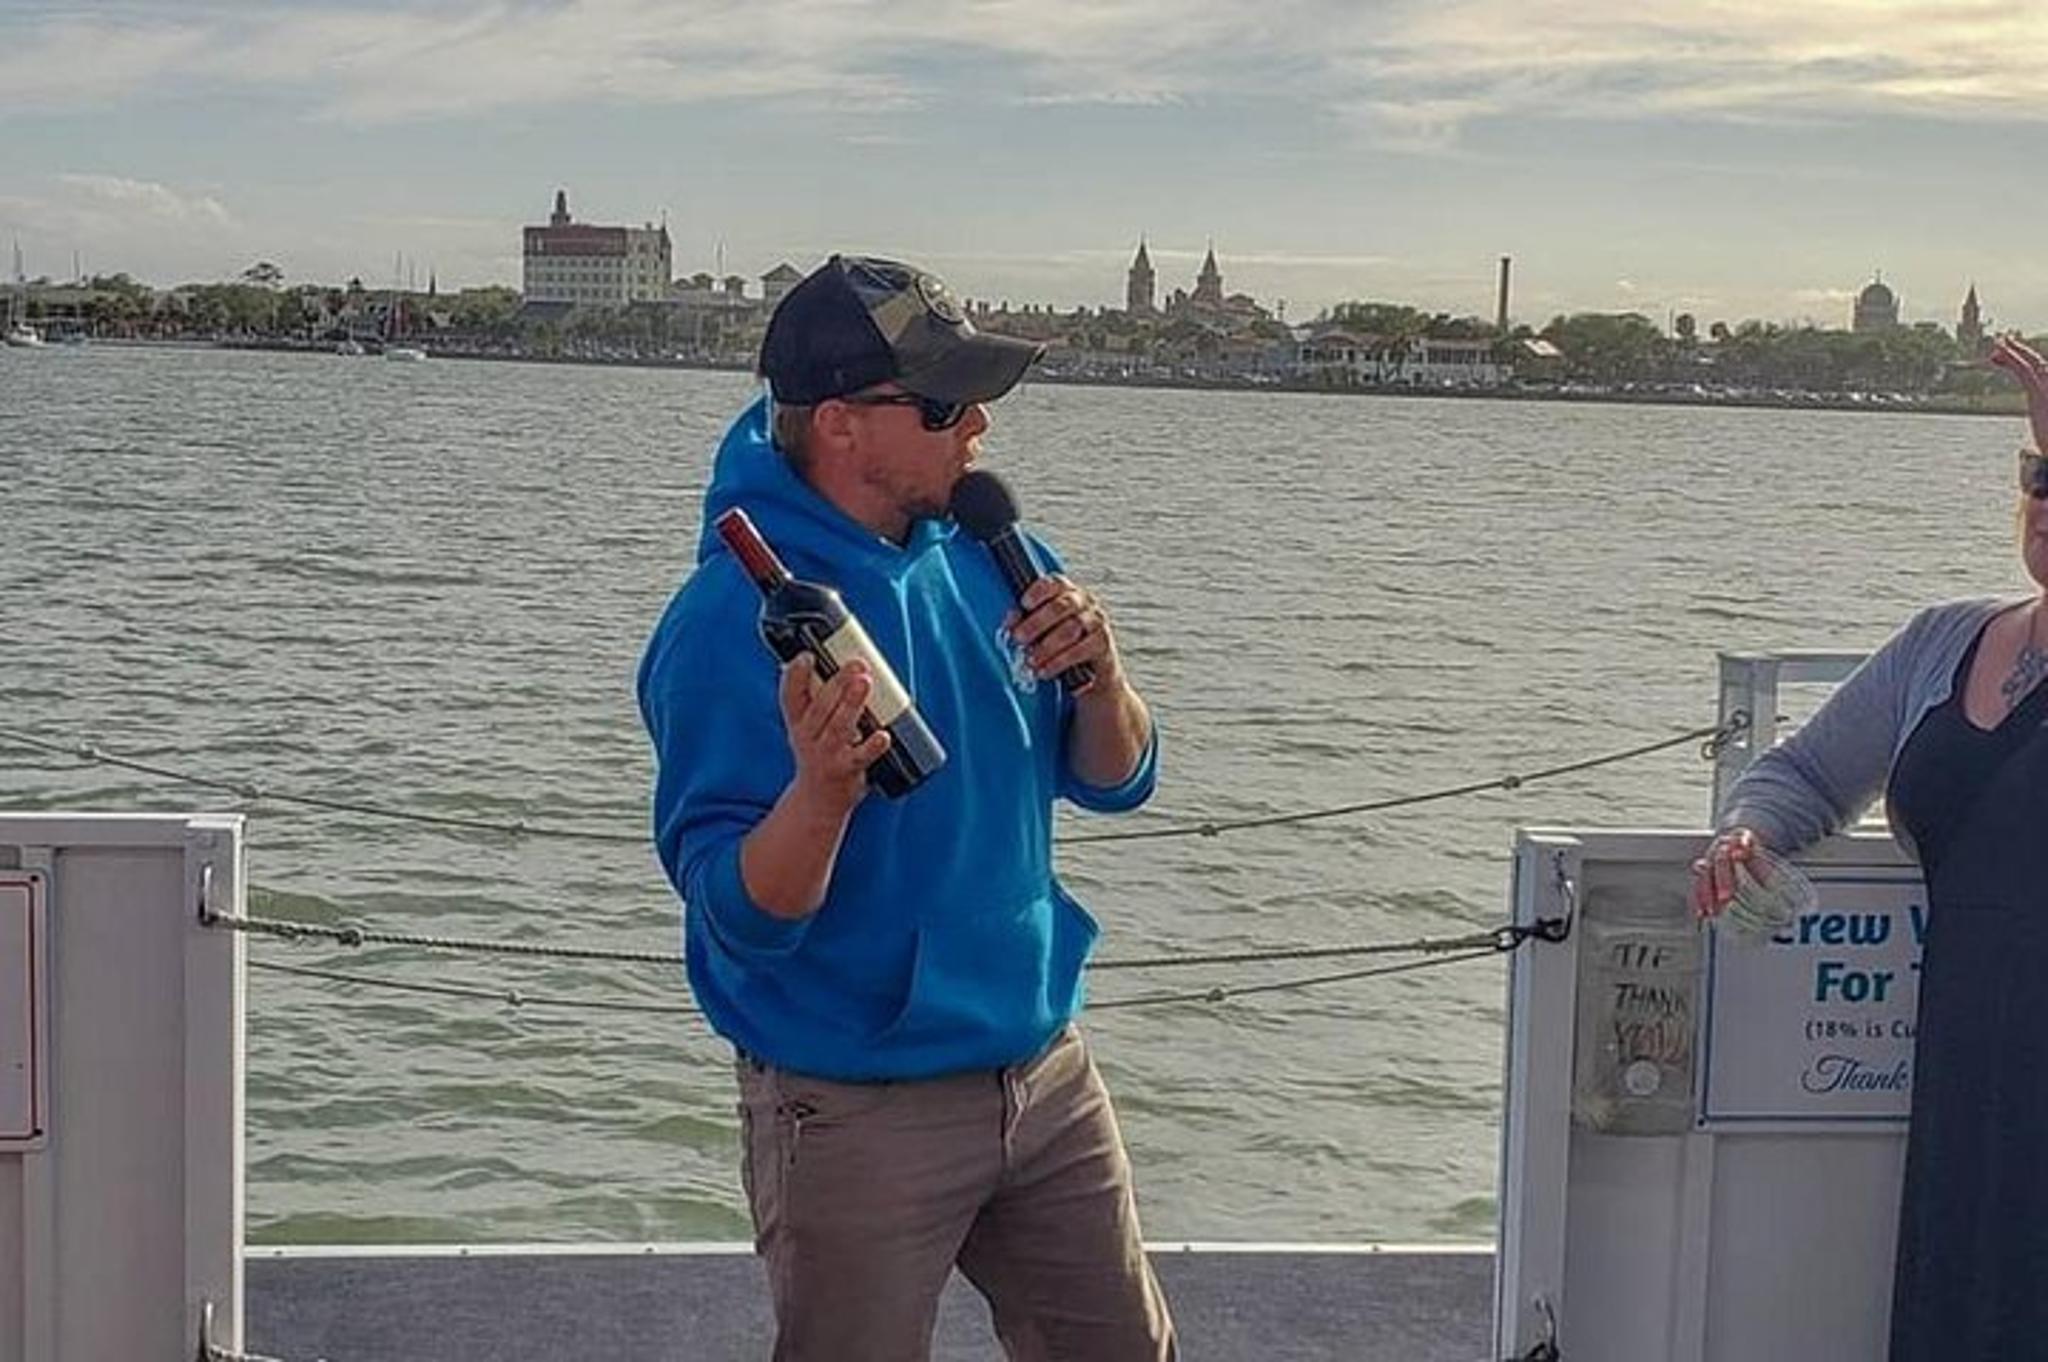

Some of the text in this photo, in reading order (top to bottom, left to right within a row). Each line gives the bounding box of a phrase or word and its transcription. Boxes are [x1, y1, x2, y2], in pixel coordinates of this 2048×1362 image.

[1772, 911, 1891, 945] rew
[1816, 961, 1895, 1002] For
[1805, 1020, 1858, 1040] (18%
[1865, 1020, 1883, 1038] is
[1801, 1054, 1910, 1094] Thank
